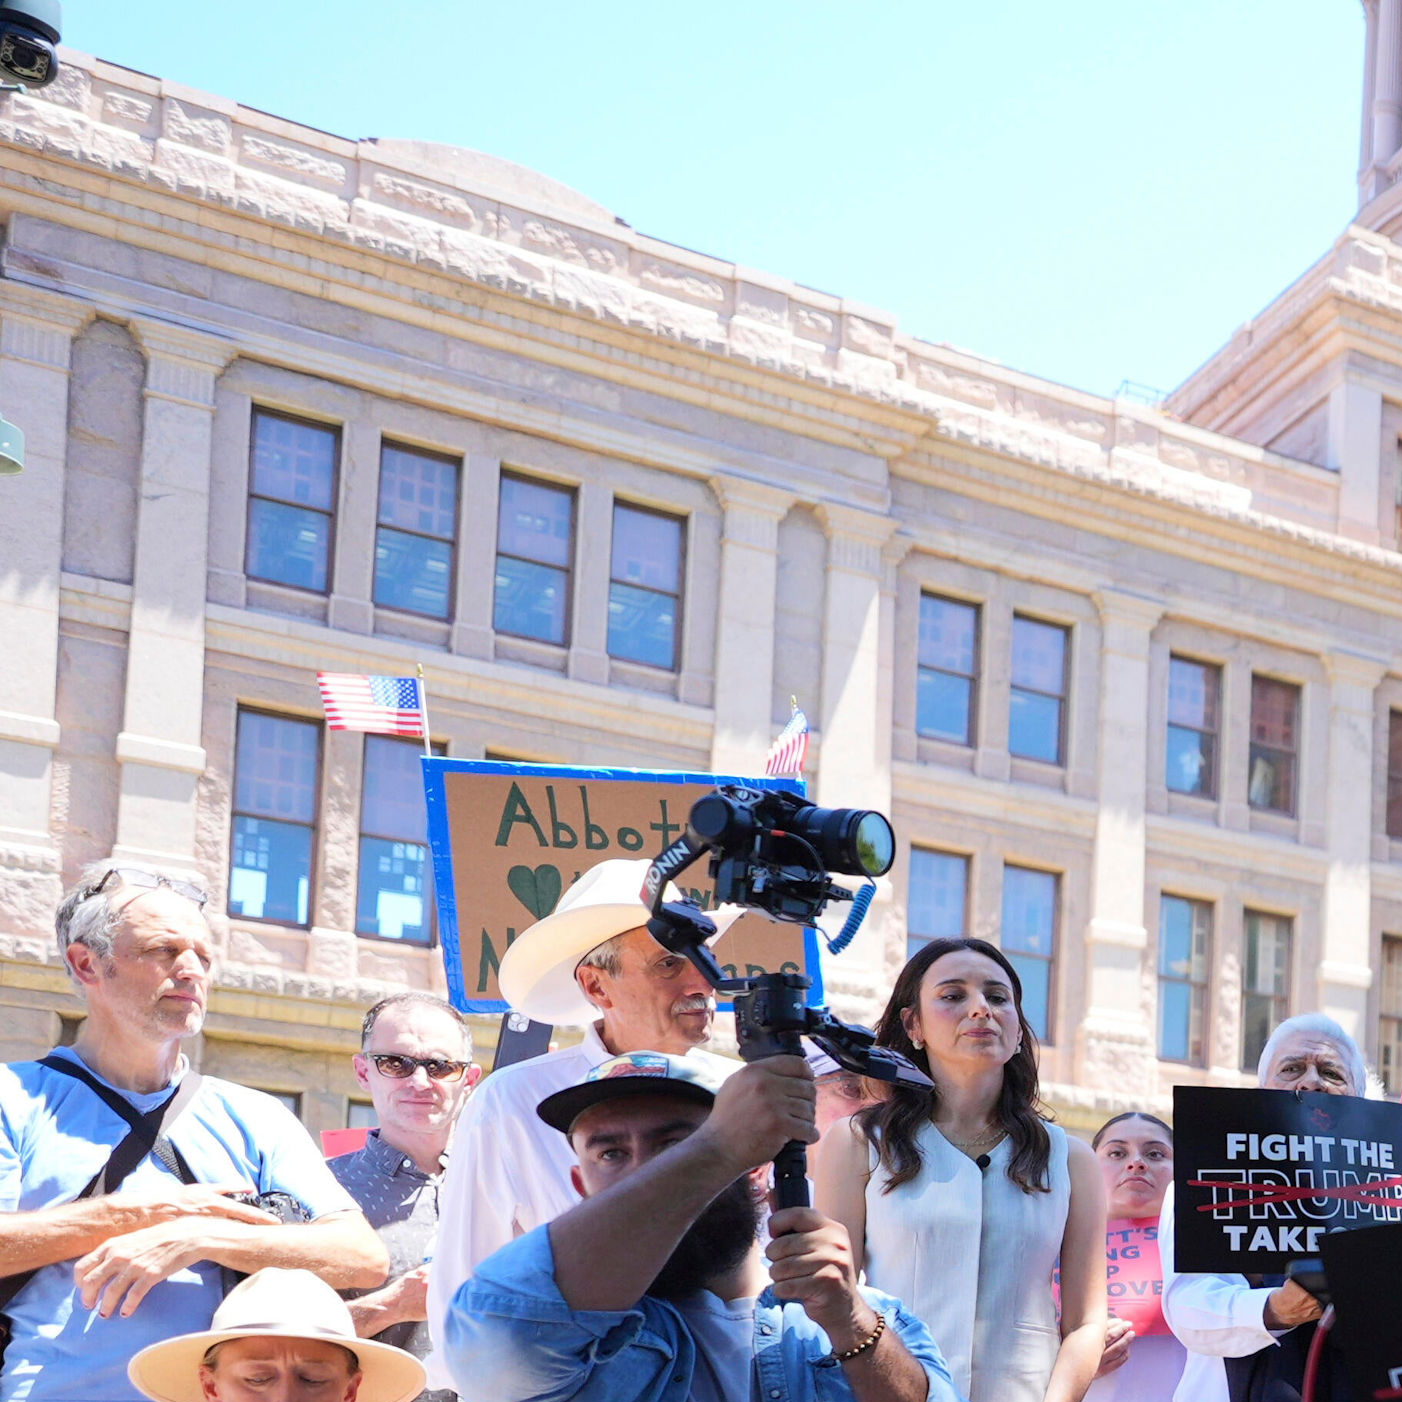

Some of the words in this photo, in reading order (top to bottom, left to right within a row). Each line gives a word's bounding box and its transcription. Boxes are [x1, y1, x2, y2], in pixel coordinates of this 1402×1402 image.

[494, 781, 689, 852] Abbot
[646, 841, 691, 894] RONIN
[1226, 1132, 1335, 1162] FIGHT
[1341, 1138, 1395, 1169] THE
[1222, 1225, 1350, 1252] TAKE
[1107, 1280, 1163, 1297] OVE
